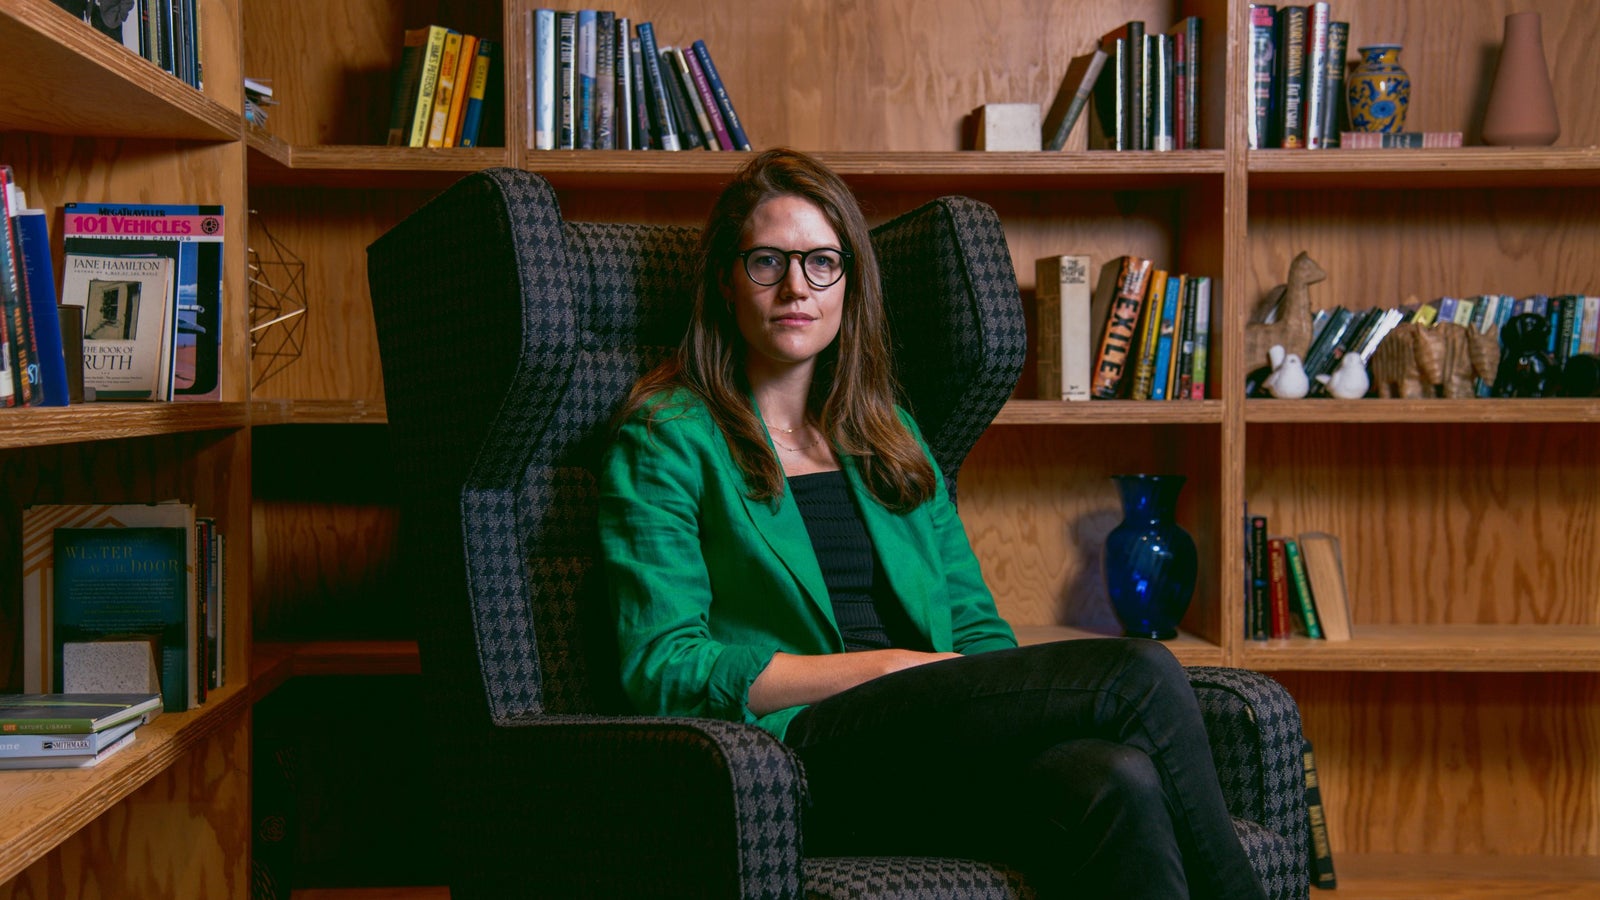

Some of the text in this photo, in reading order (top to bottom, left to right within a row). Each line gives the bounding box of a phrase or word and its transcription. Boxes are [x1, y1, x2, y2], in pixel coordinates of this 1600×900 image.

[429, 43, 440, 62] JAMES
[1287, 11, 1303, 77] SANDRA BROWN
[422, 64, 436, 97] PATTERSON
[74, 216, 192, 234] 101 VEHICLES
[73, 259, 160, 271] JANE HAMILTON
[14, 307, 25, 345] NOAH
[1100, 297, 1139, 376] EXILE
[84, 355, 132, 370] RUTH
[131, 559, 180, 576] DOOR
[52, 740, 90, 750] SMITHMARK
